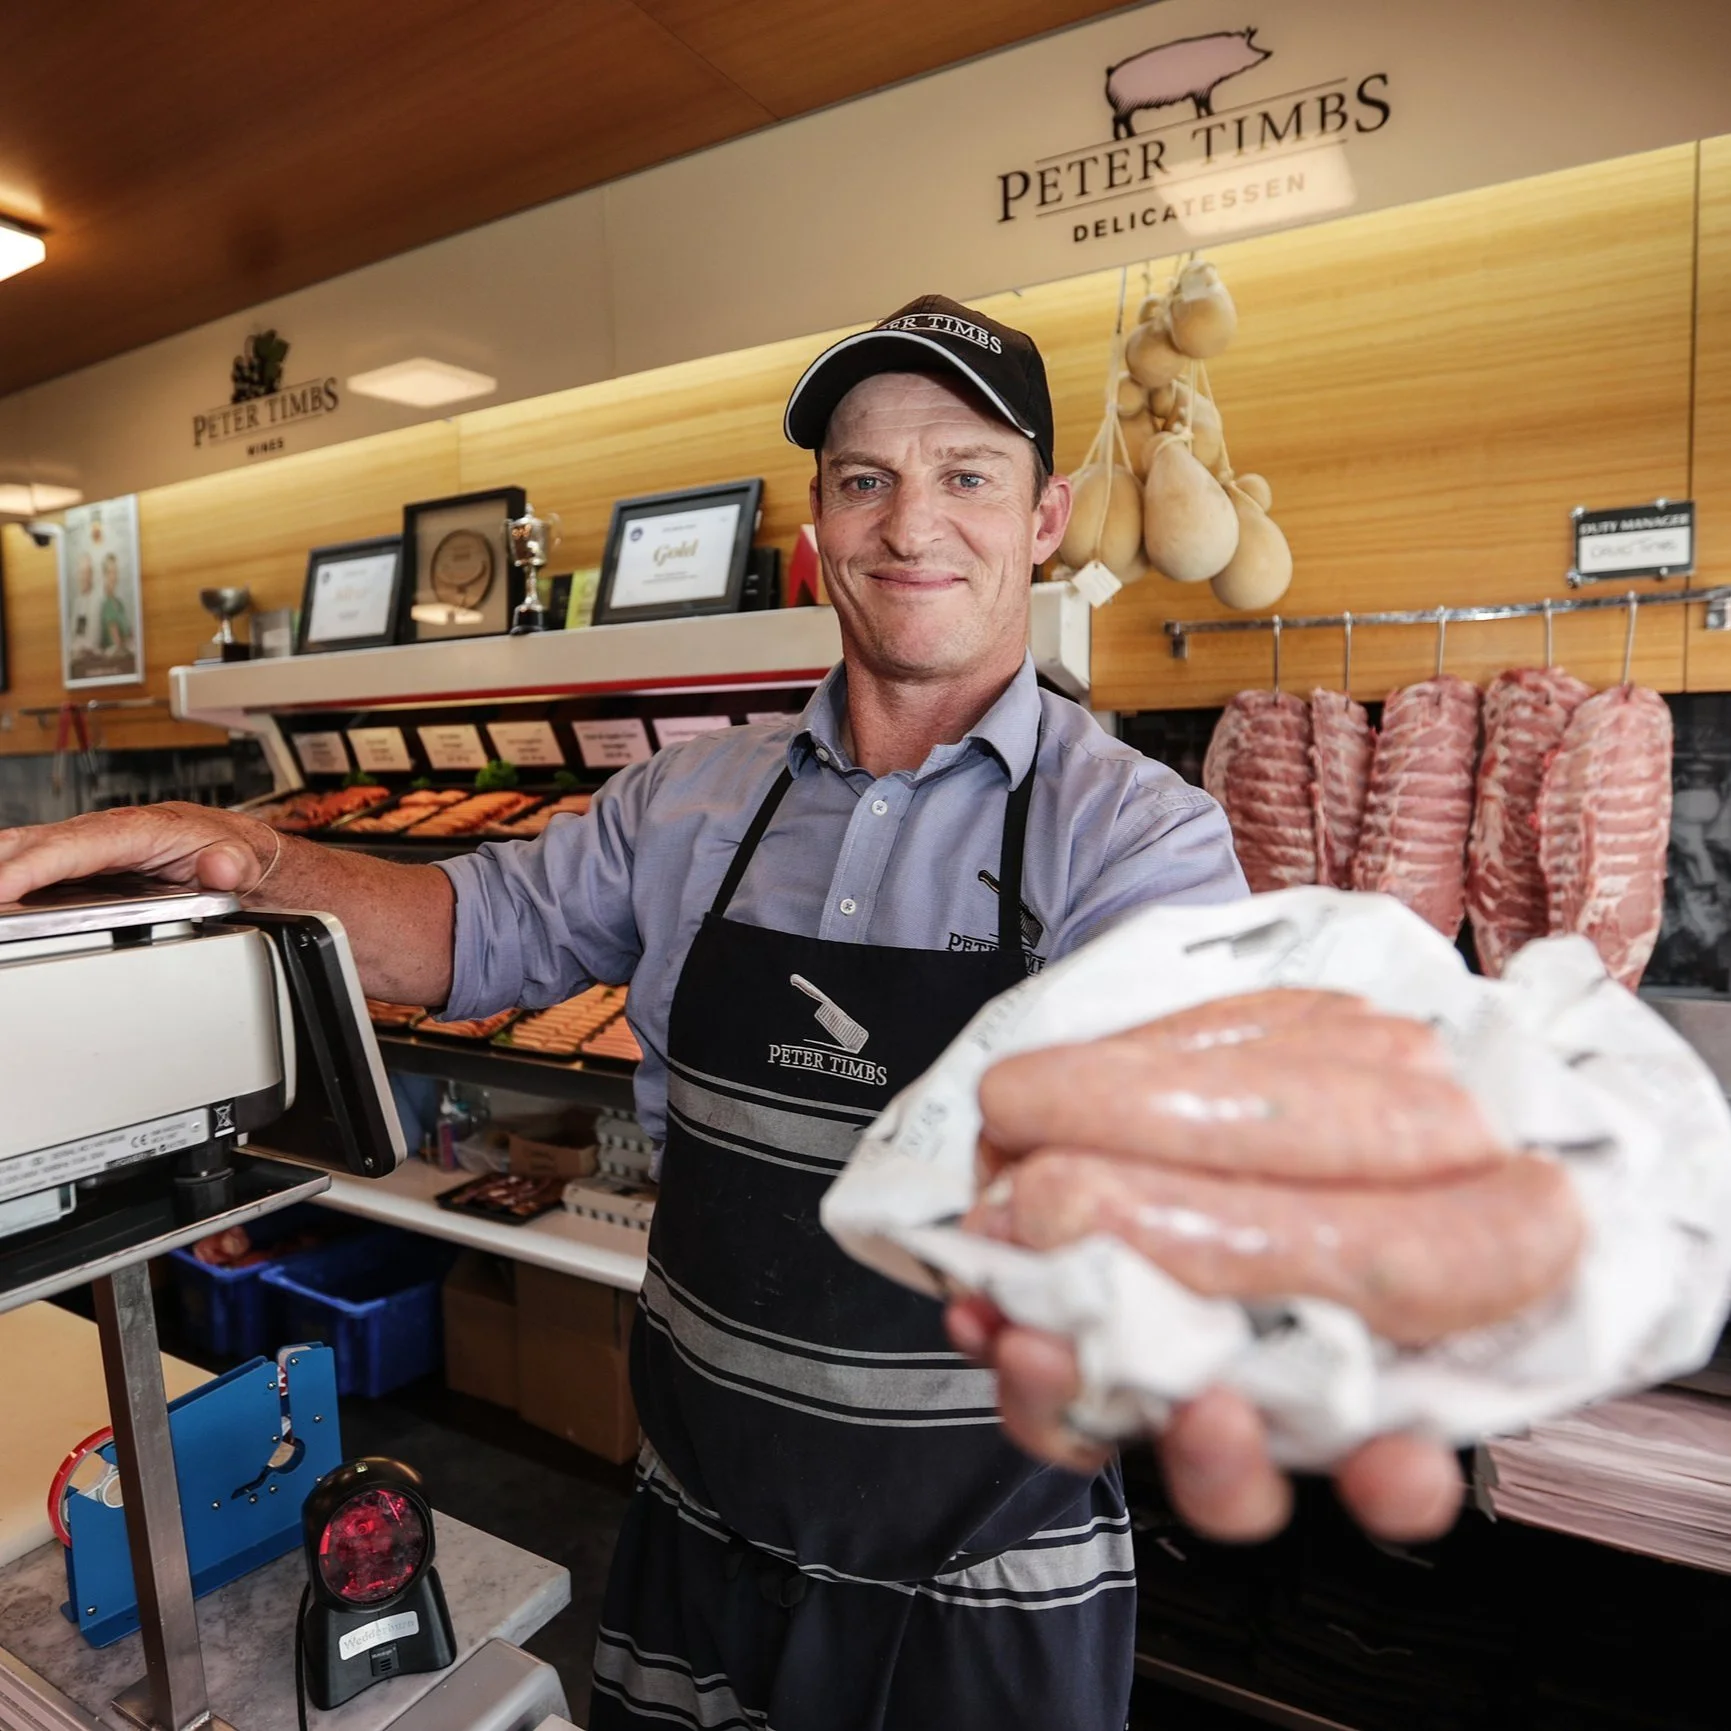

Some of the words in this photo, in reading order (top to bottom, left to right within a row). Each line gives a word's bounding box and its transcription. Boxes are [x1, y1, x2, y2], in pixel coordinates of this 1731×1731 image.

[997, 140, 1171, 223] PETER
[1191, 73, 1391, 164] TIMBS
[1073, 173, 1306, 242] DELICATESSEN
[928, 316, 1002, 354] TIMBS
[193, 404, 260, 446] PETER
[268, 377, 339, 423] TIMBS
[247, 437, 284, 455] WINES
[1621, 514, 1689, 531] MANAGER
[768, 1045, 824, 1070] PETER
[830, 1056, 887, 1086] TIMBS
